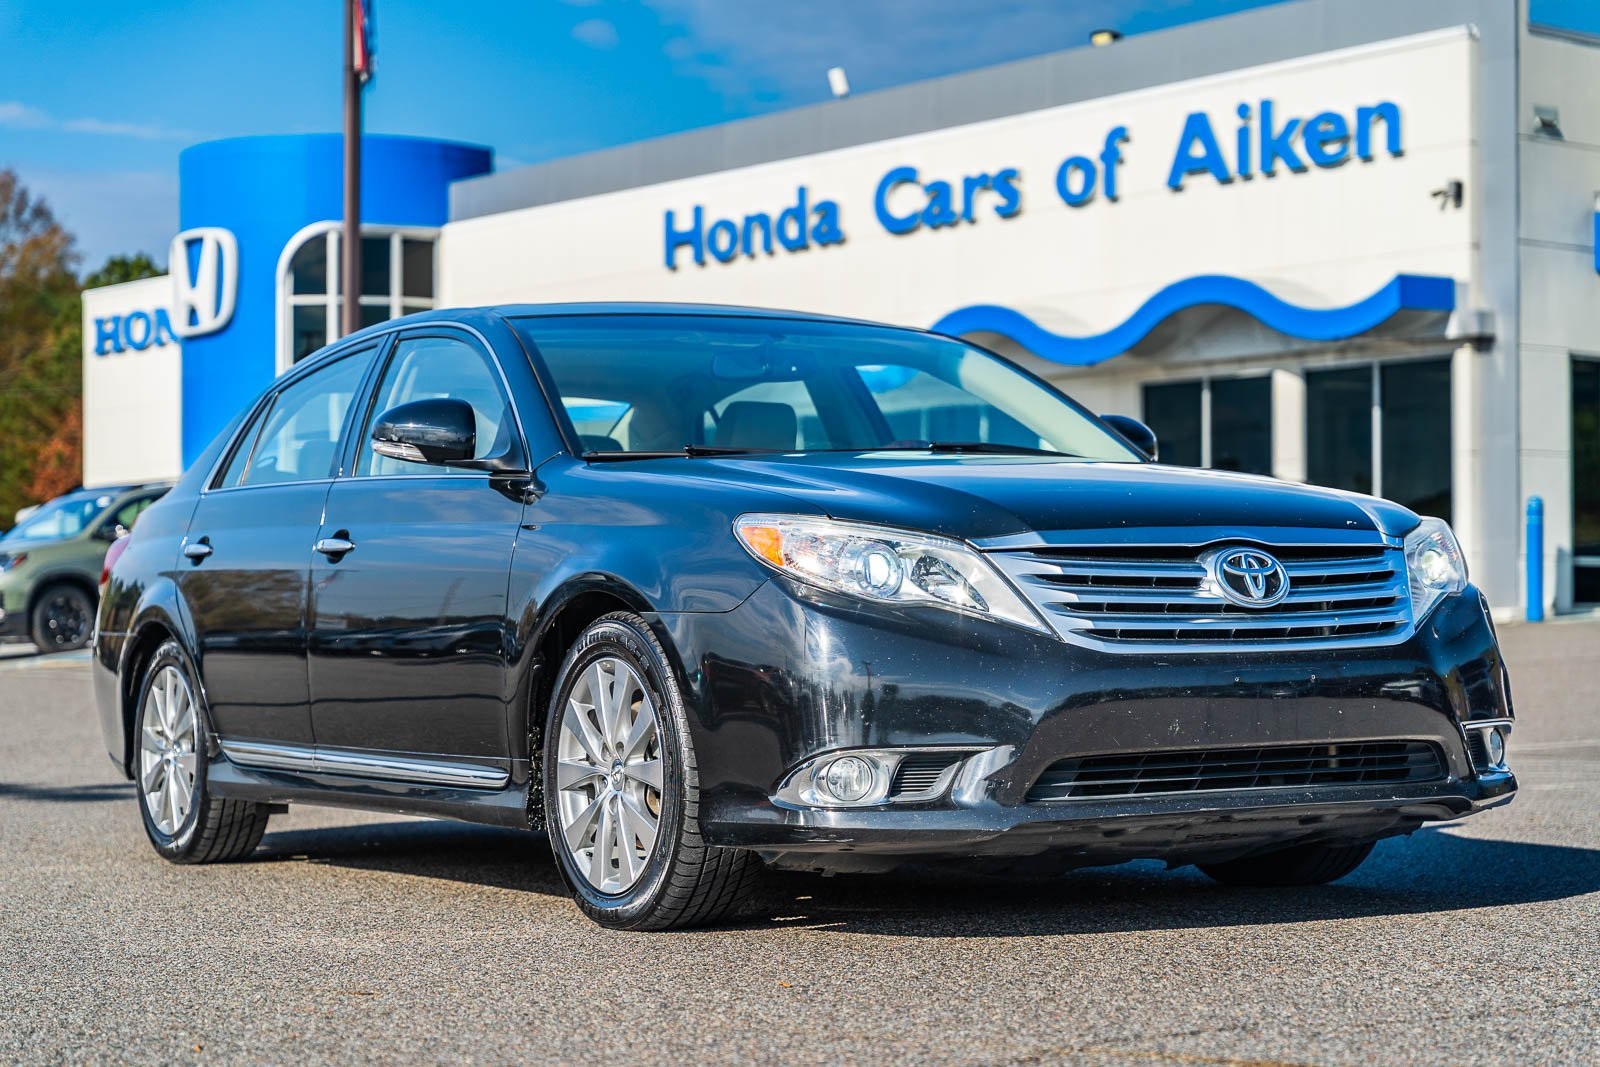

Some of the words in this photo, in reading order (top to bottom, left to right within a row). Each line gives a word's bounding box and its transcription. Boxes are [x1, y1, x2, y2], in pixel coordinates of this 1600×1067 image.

[664, 185, 845, 270] Honda
[874, 166, 1021, 236] Cars
[1056, 125, 1128, 207] of
[1168, 99, 1405, 192] Aiken
